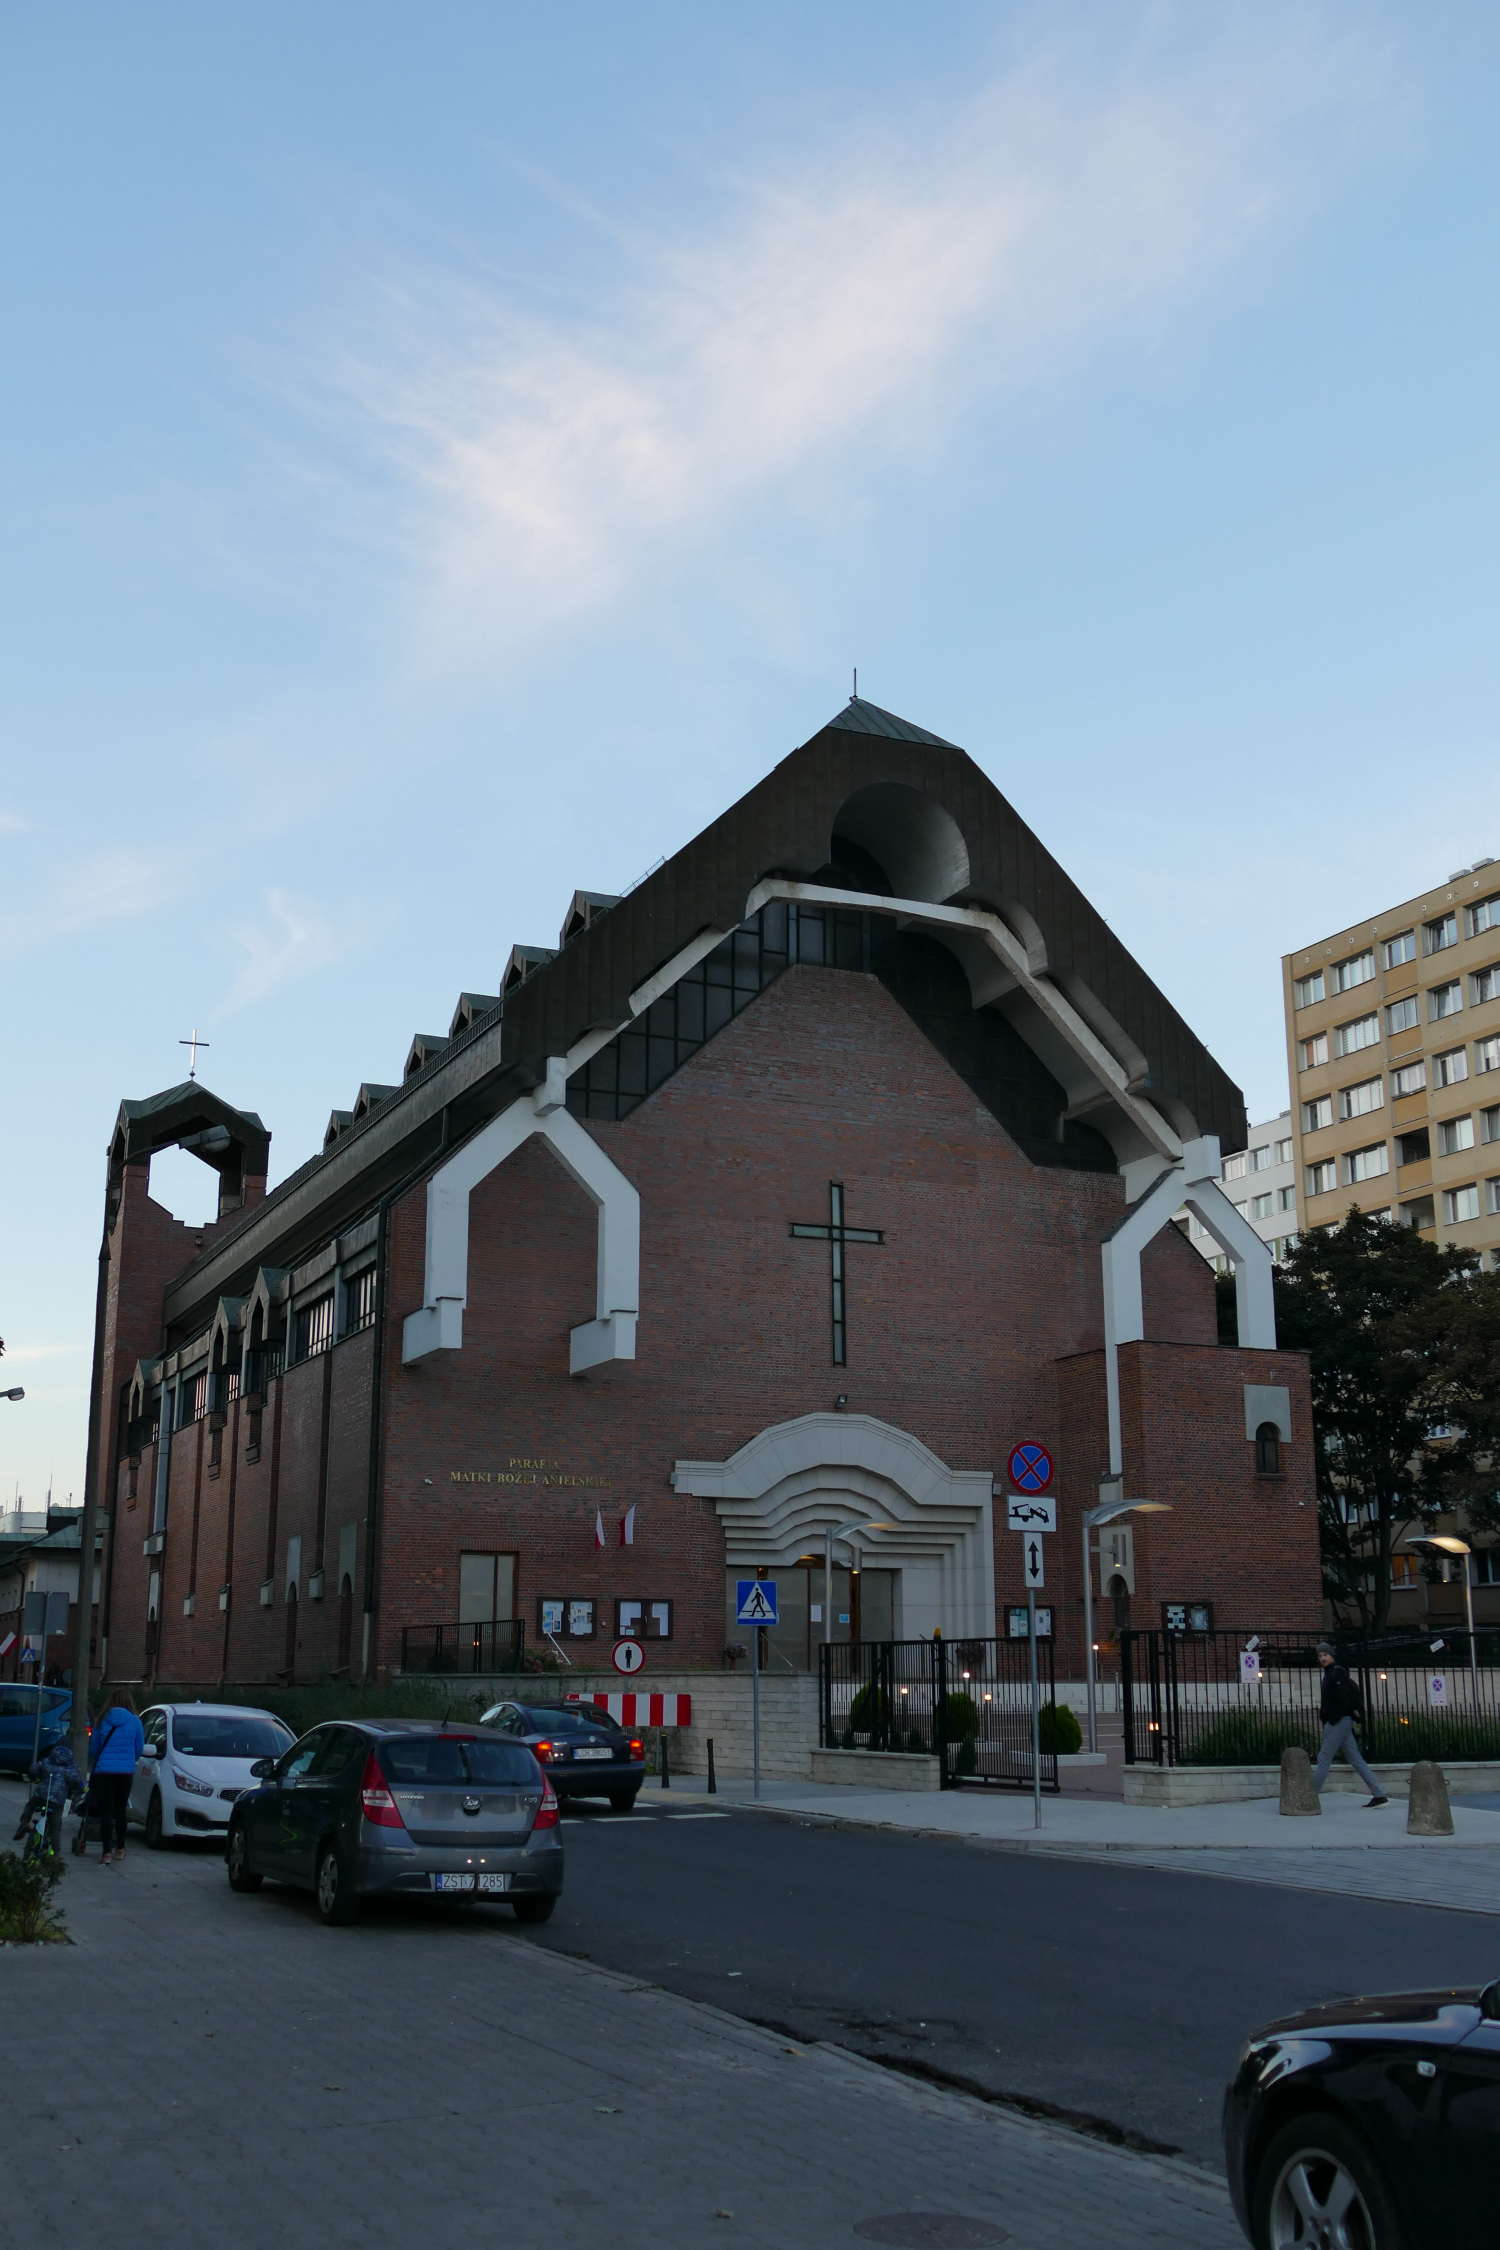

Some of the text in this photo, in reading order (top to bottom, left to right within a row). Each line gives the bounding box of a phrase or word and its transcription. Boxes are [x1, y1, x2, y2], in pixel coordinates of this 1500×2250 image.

[509, 1458, 560, 1470] PARAFIA
[450, 1471, 613, 1487] MATKI BOŻEJ ANIELSKIEJ
[443, 1875, 466, 1888] ZST
